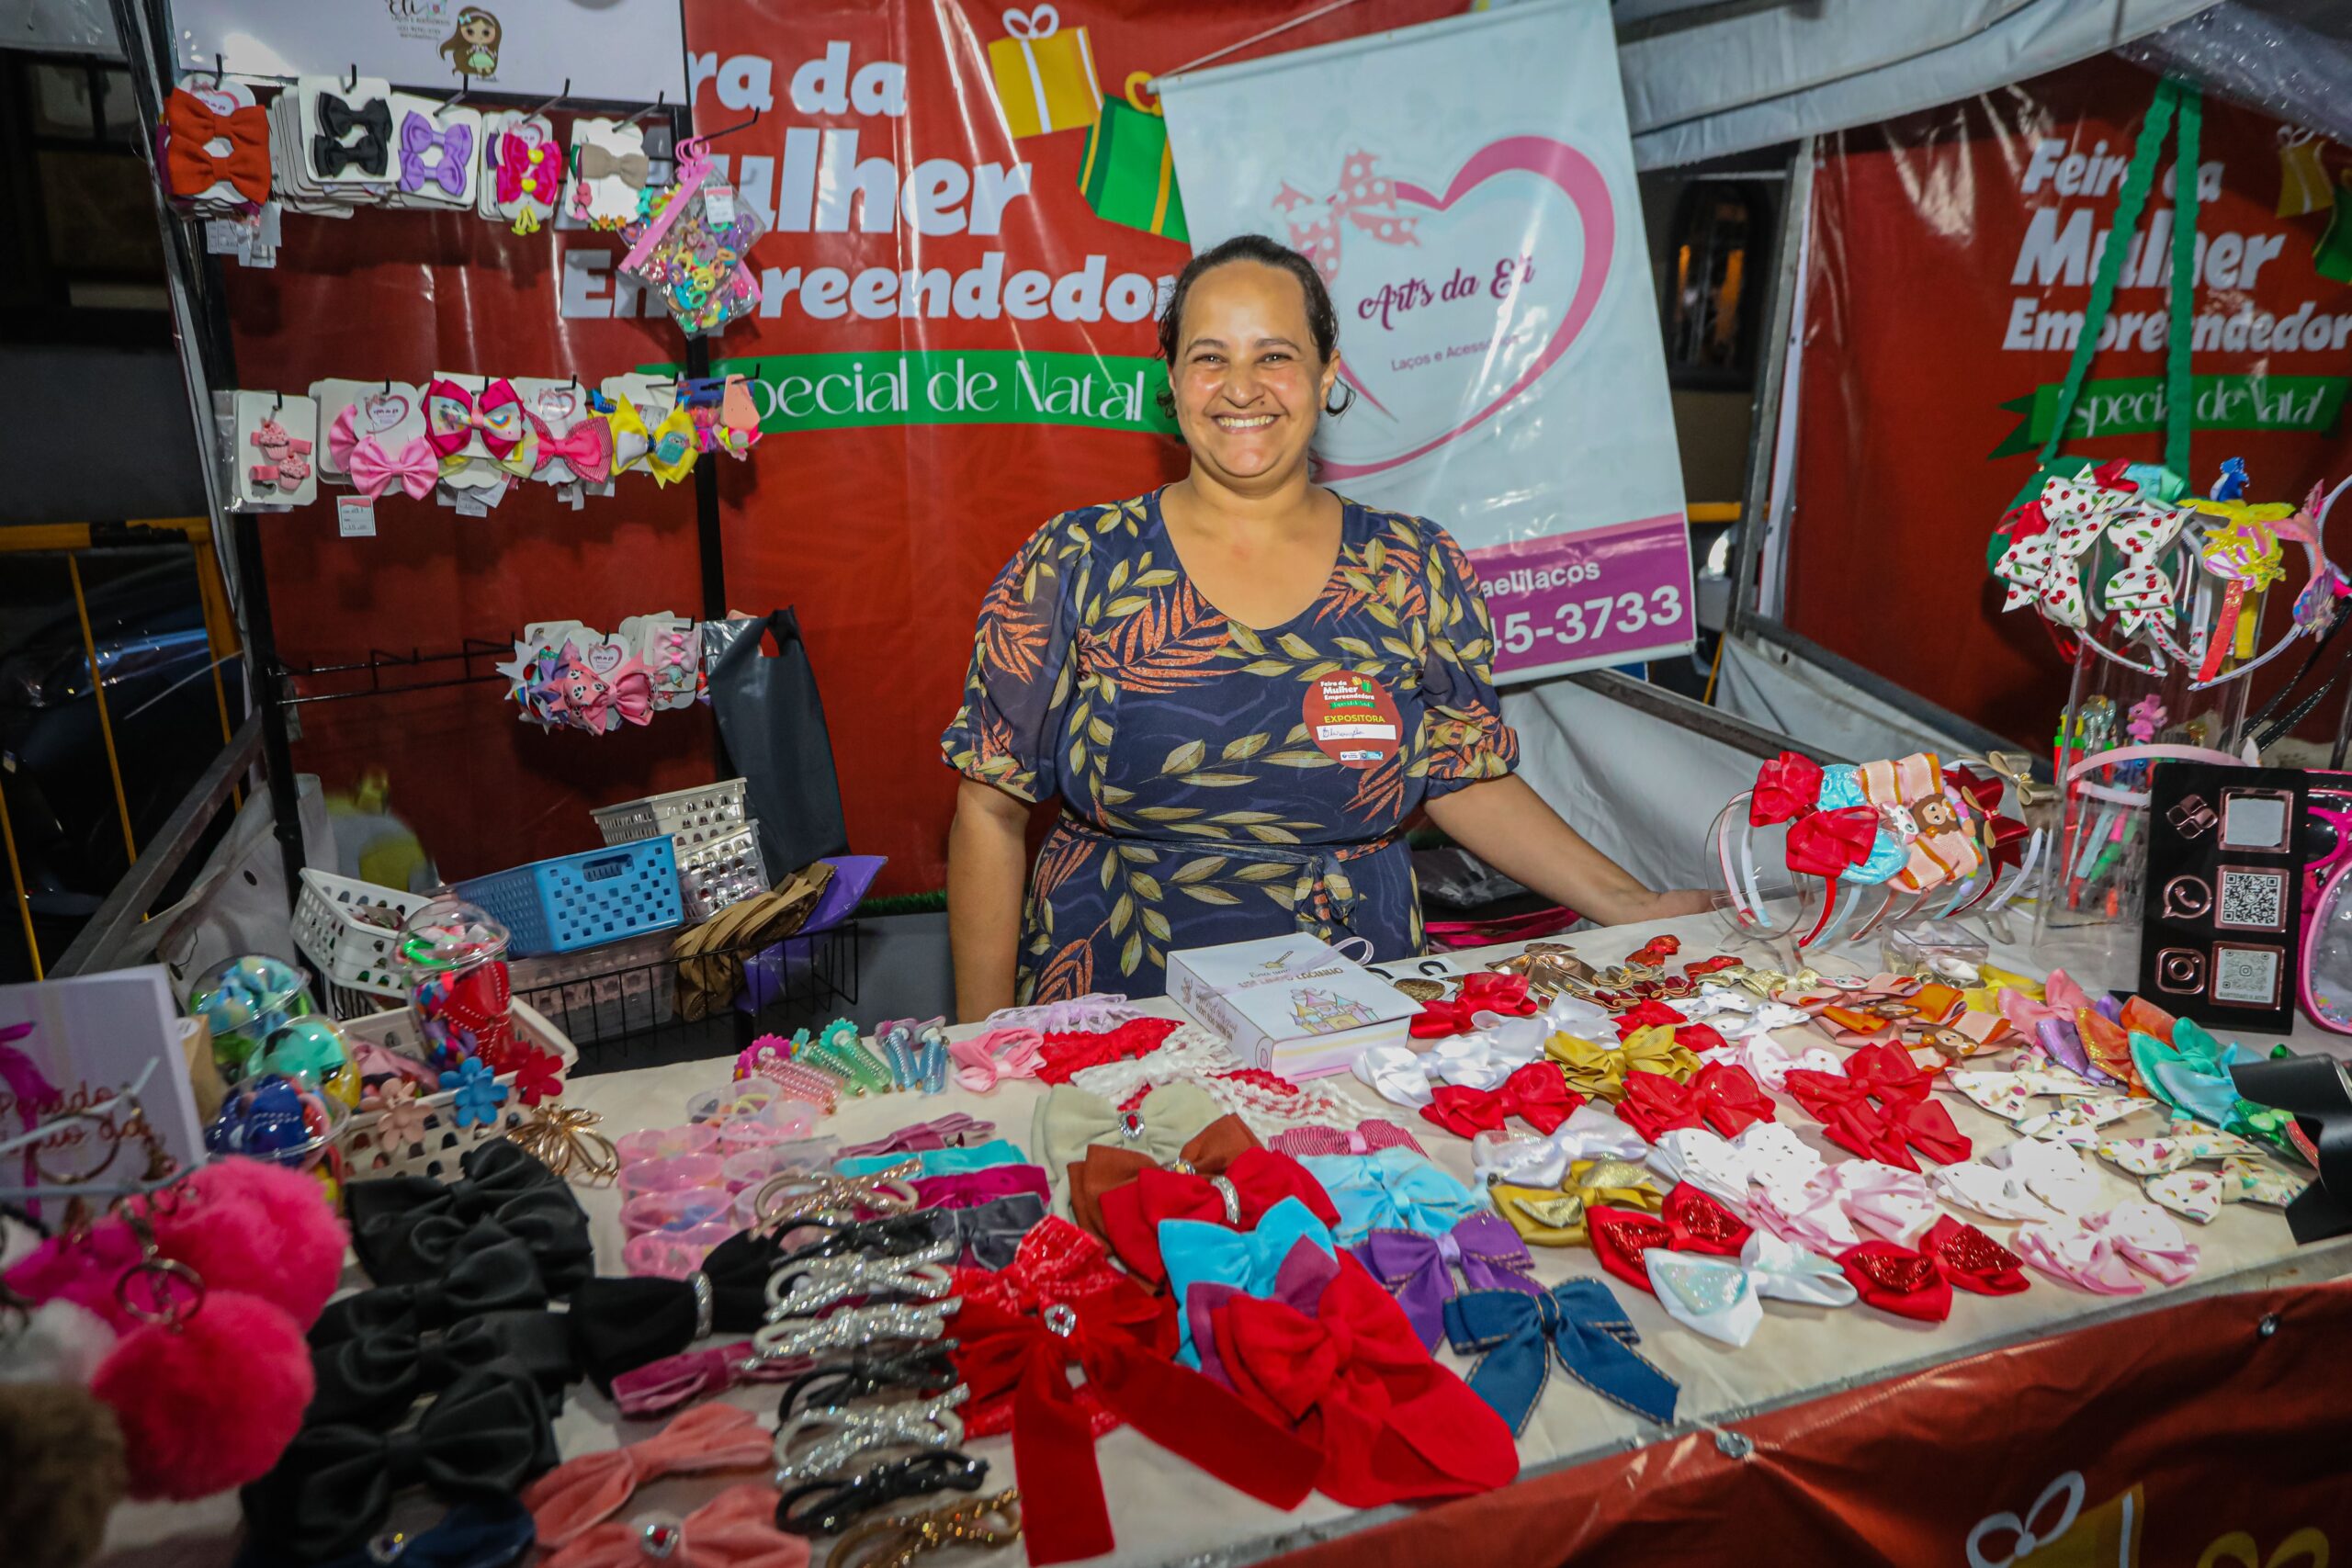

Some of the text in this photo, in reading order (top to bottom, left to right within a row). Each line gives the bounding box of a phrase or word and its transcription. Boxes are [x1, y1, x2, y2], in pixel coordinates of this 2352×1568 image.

[790, 40, 906, 117] da
[1357, 252, 1536, 331] Art's da Ei
[1391, 353, 1431, 372] Laços
[1434, 350, 1443, 361] e
[927, 358, 999, 412] de
[1014, 359, 1145, 423] Natal
[2196, 378, 2238, 421] de
[1323, 686, 1358, 694] Mulher
[1324, 714, 1385, 724] EXPOSITORA
